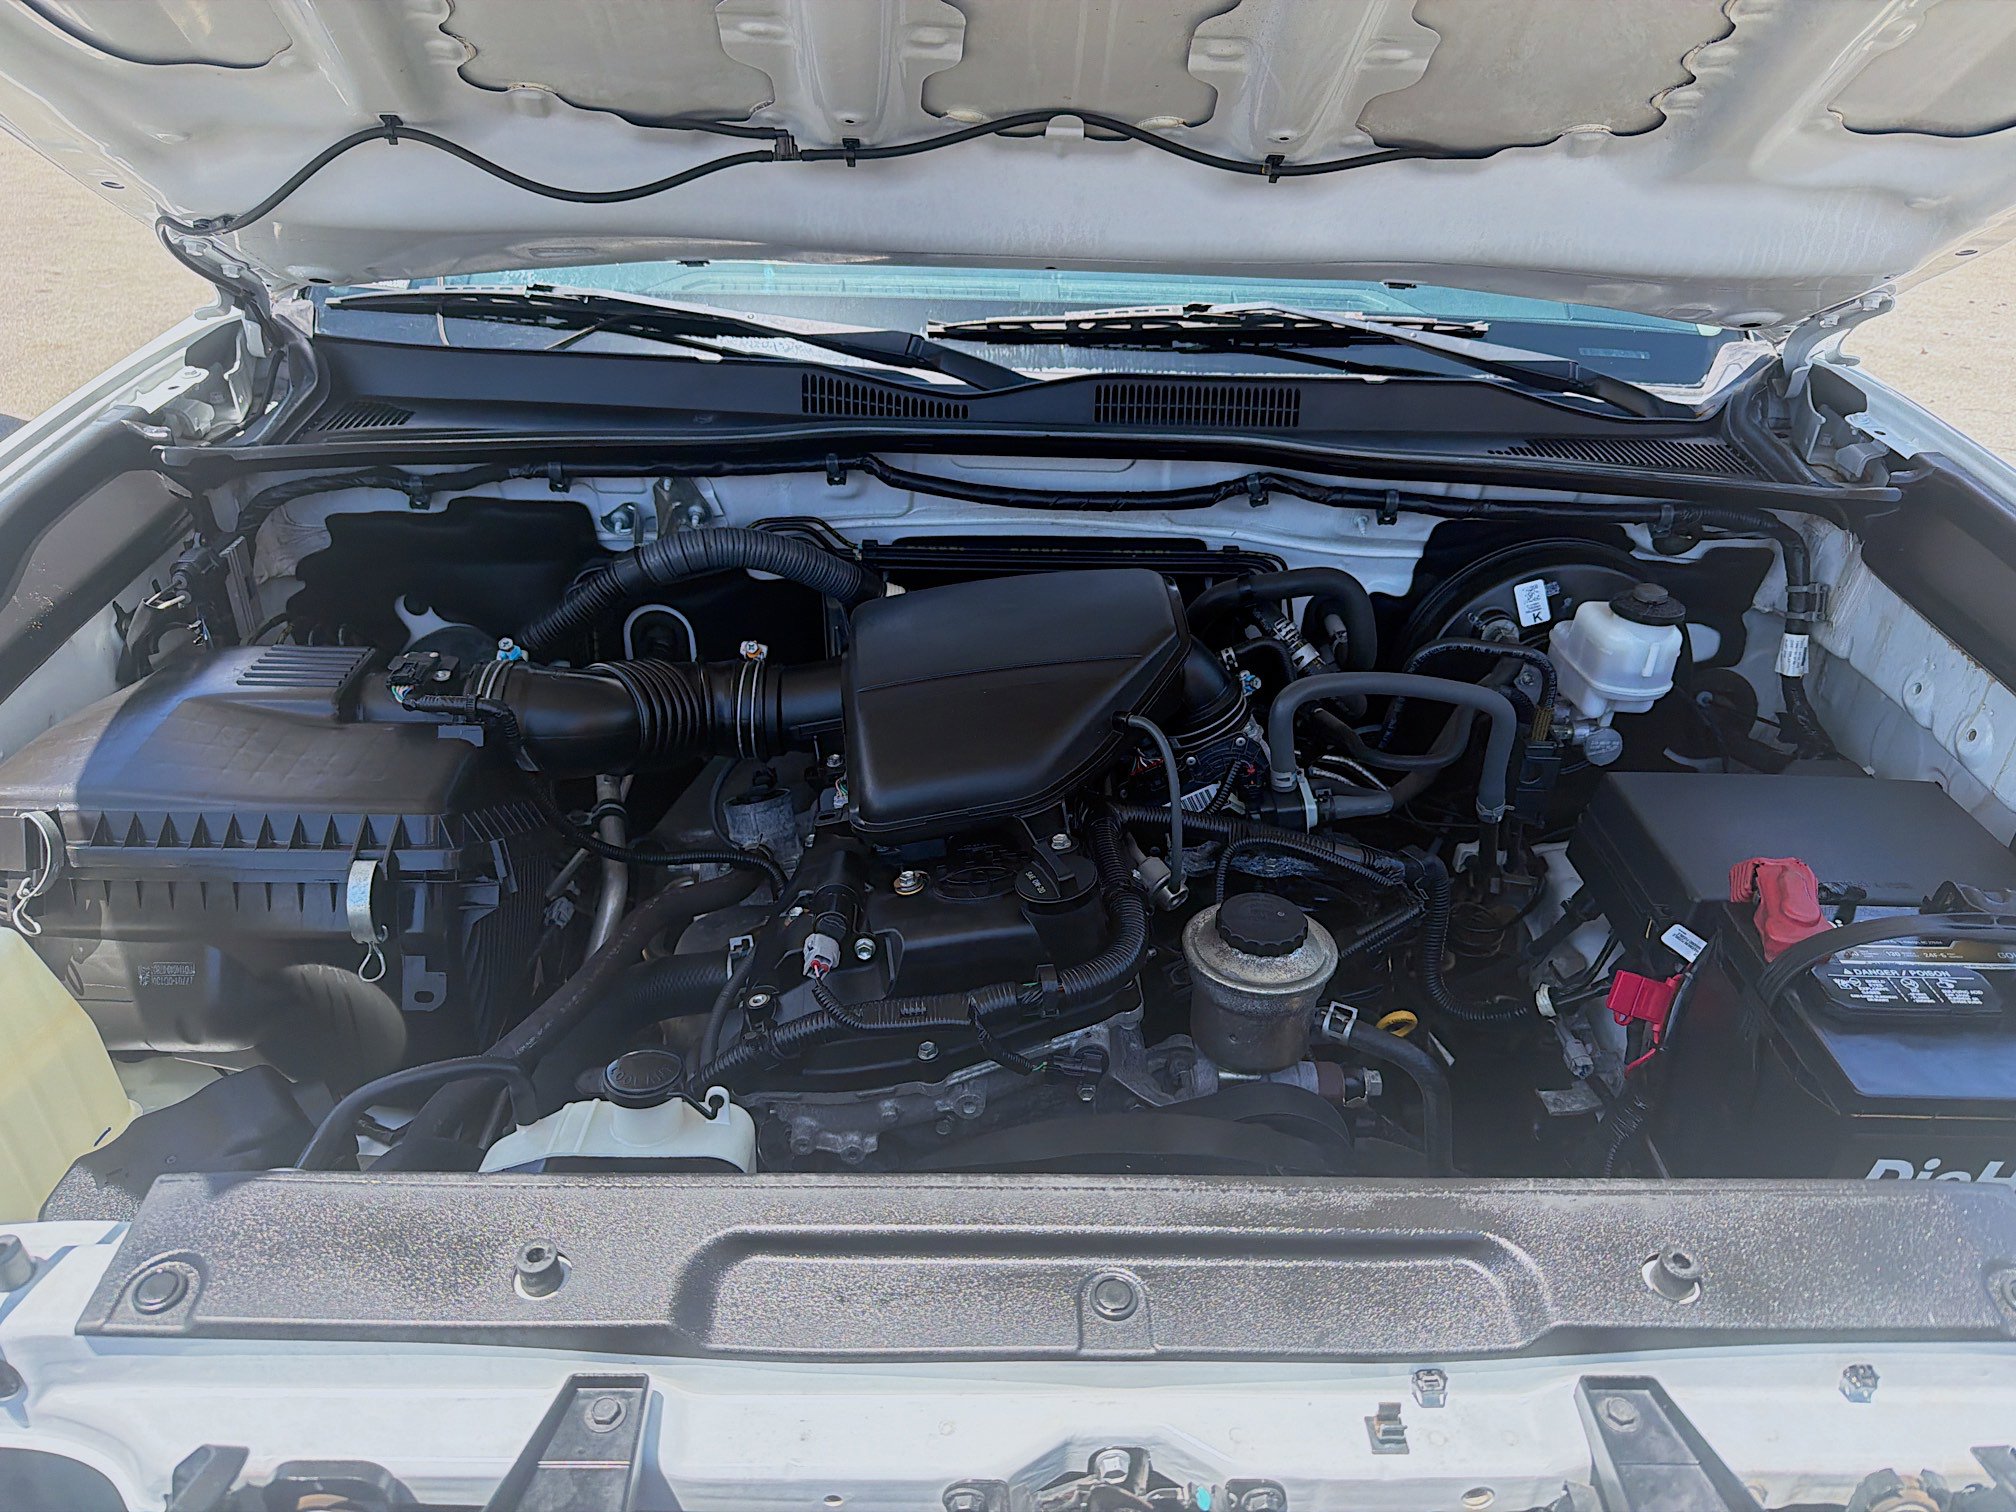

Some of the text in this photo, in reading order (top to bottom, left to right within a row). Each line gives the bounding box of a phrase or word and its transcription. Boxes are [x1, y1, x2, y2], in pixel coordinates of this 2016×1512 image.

[1532, 611, 1543, 623] K
[1025, 871, 1037, 881] SAE
[1852, 968, 1900, 976] DANGER
